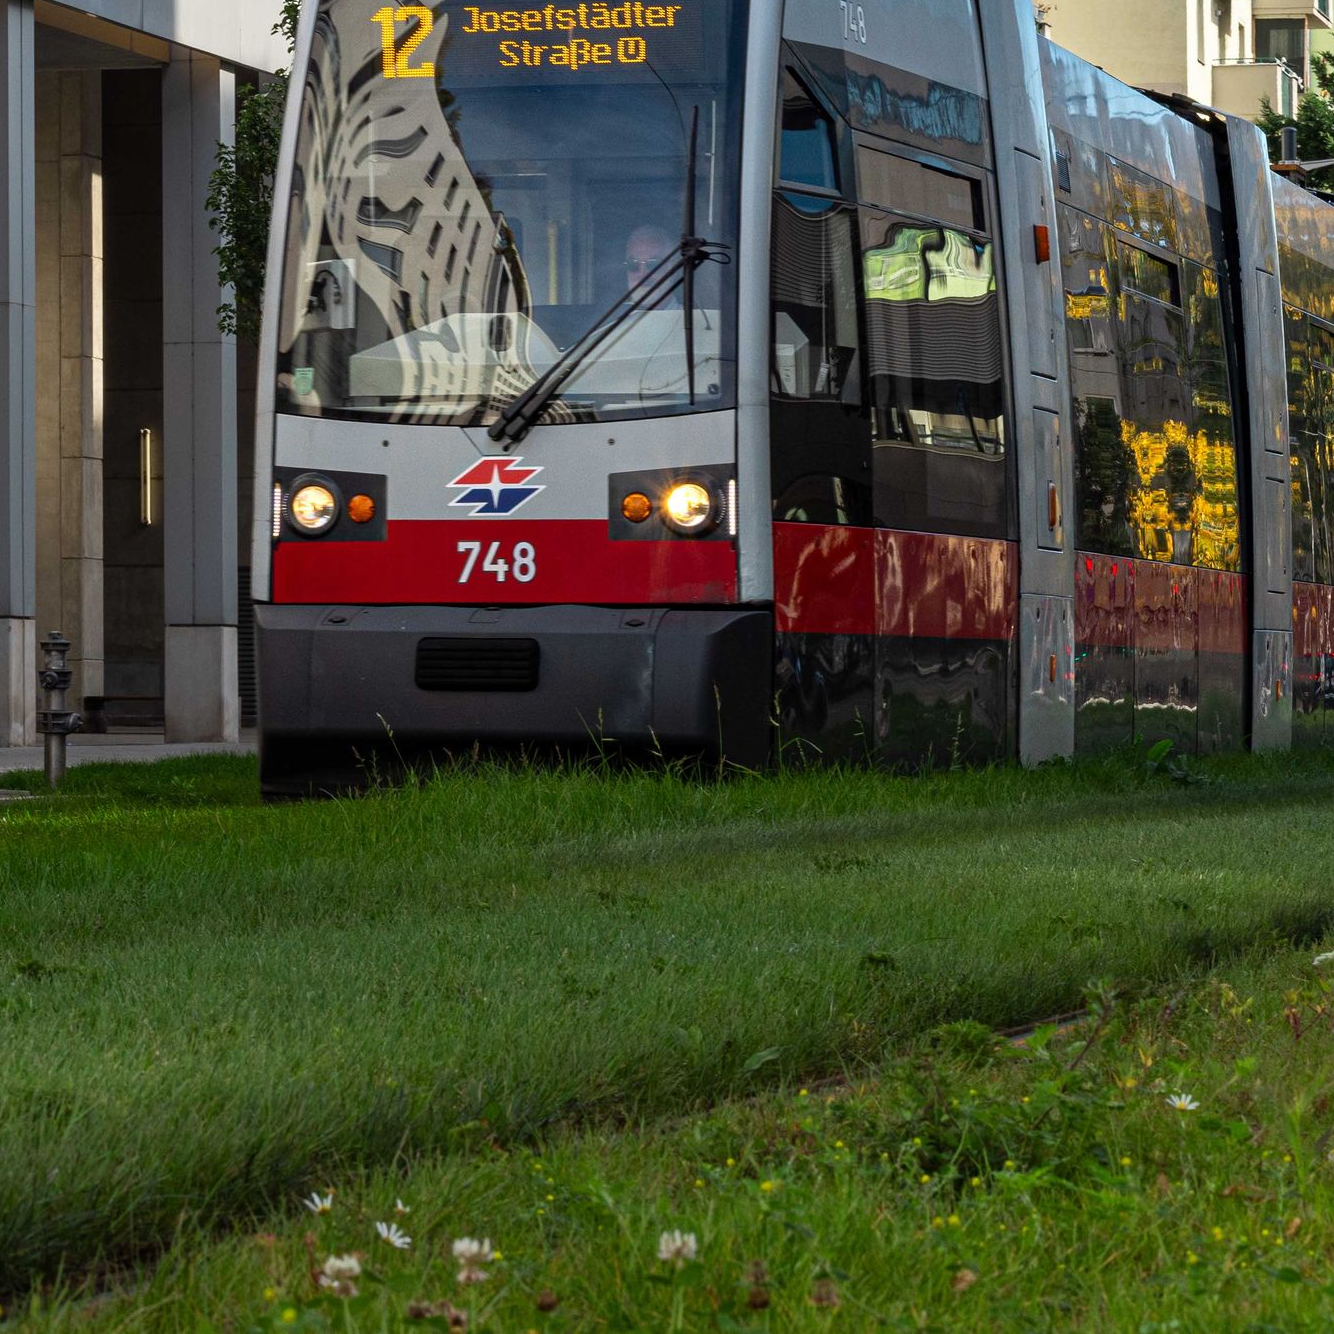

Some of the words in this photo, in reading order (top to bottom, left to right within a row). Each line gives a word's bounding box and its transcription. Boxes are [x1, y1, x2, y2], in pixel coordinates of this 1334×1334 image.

[462, 1, 682, 33] Josefstädter
[839, 0, 867, 45] 748
[370, 6, 435, 78] 12
[499, 37, 612, 71] Straße
[457, 541, 537, 583] 748
